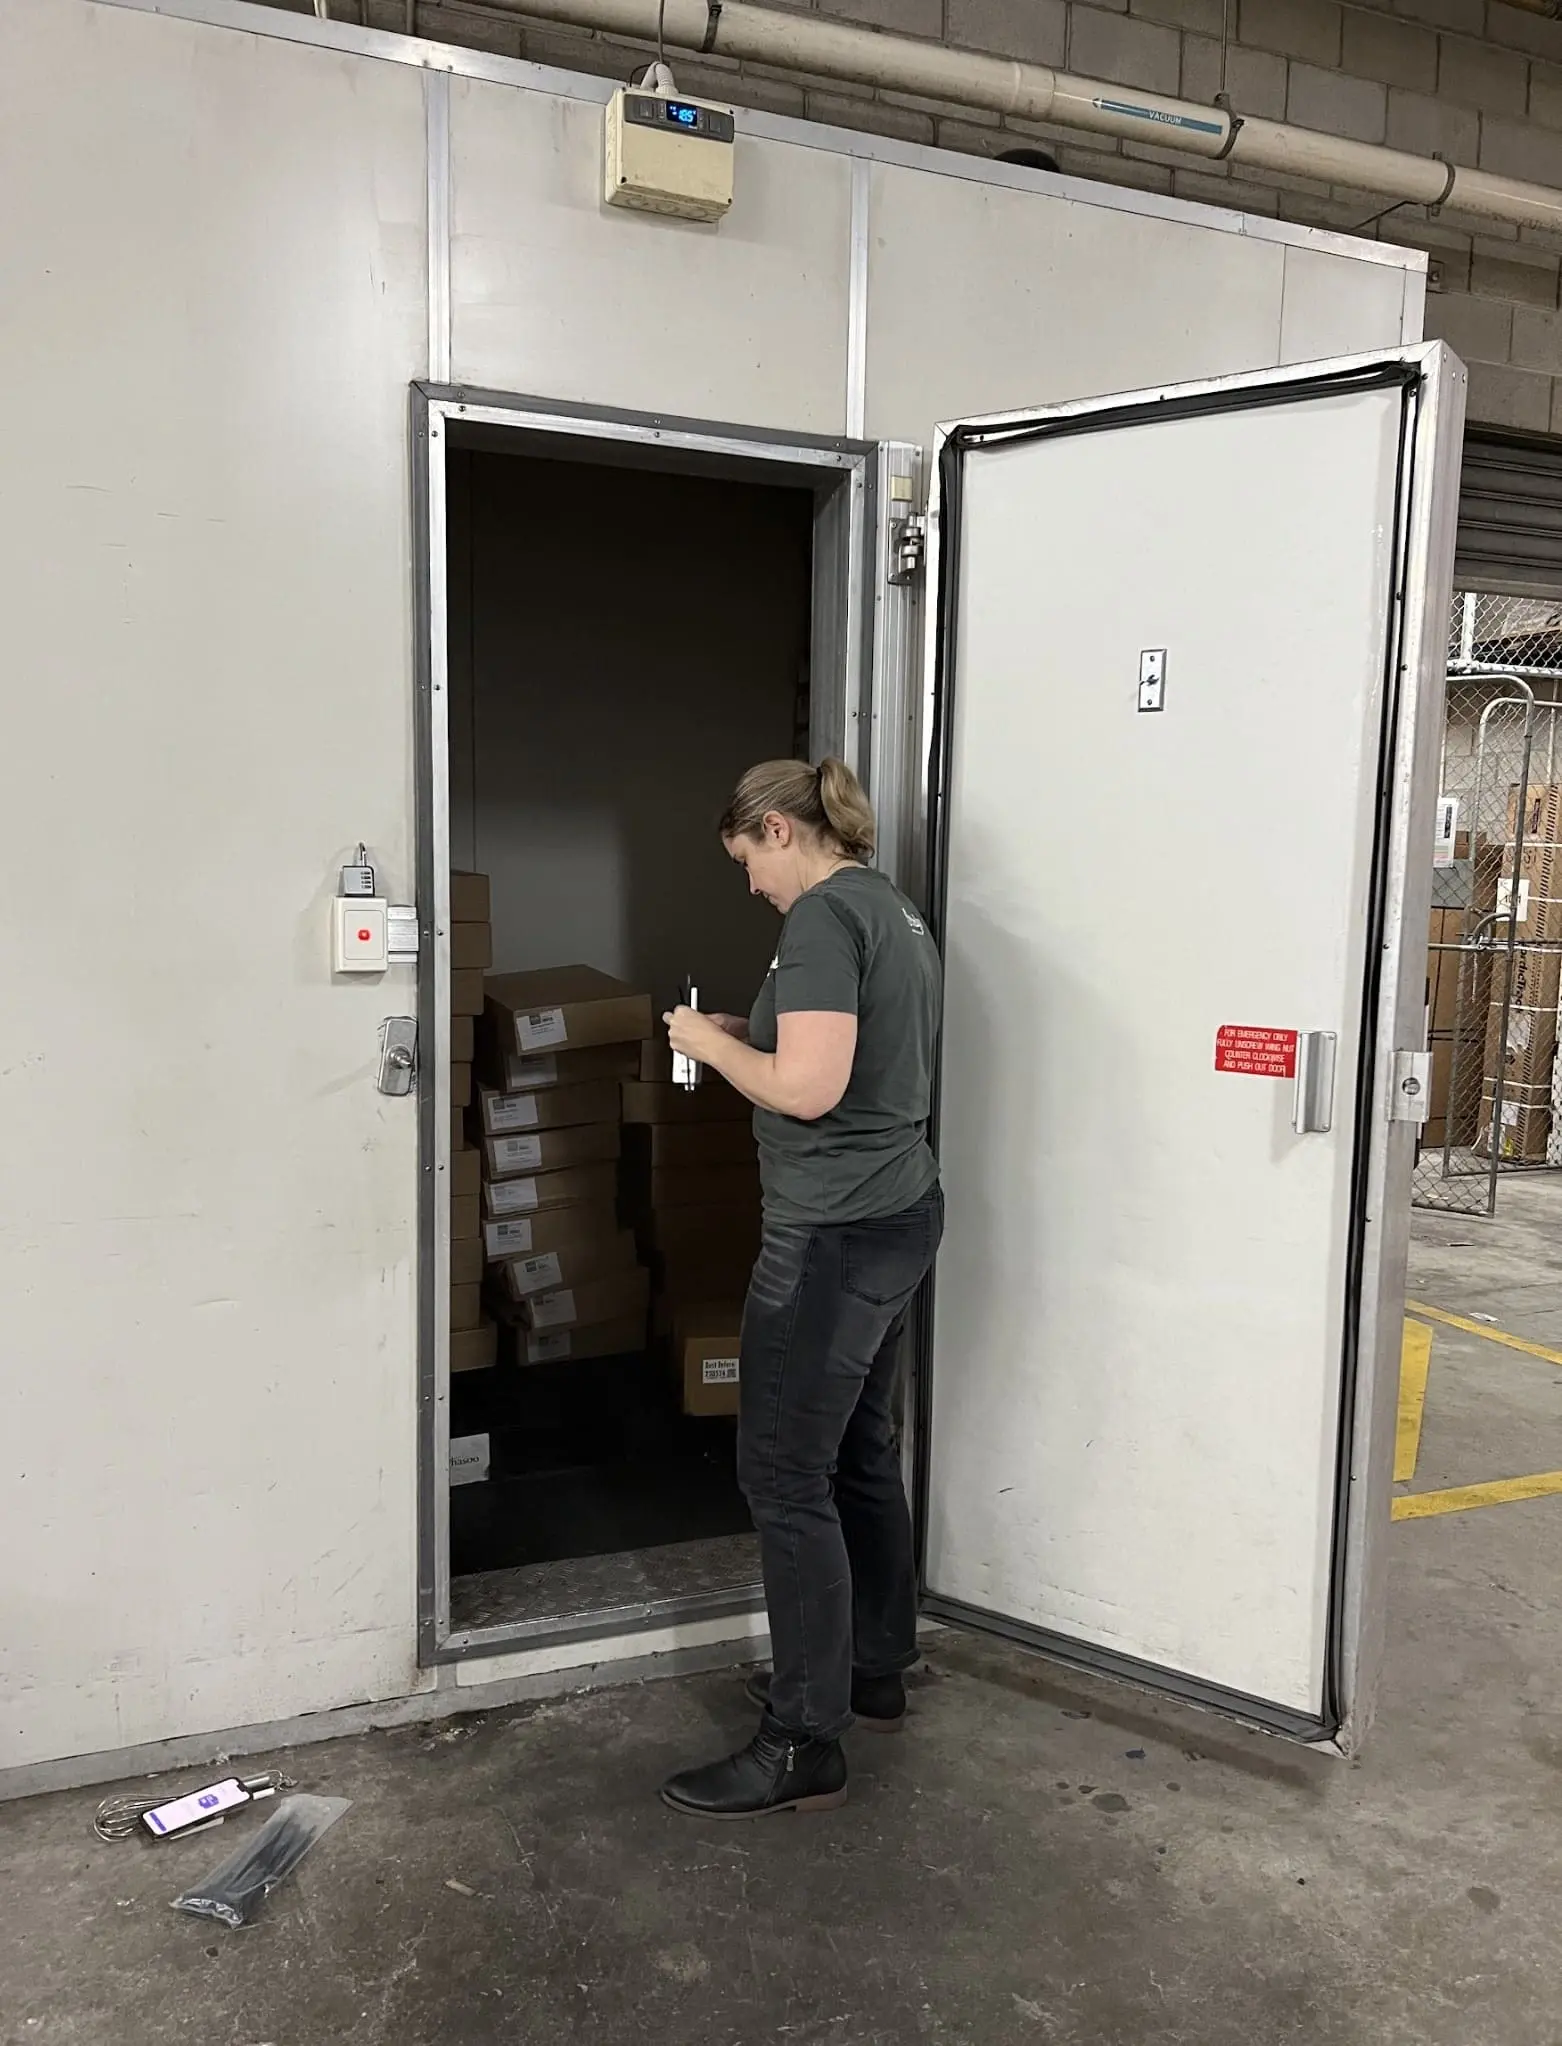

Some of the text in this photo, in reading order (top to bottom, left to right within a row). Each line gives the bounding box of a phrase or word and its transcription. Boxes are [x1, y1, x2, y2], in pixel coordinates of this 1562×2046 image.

[1149, 111, 1181, 125] VACUUM
[1516, 941, 1528, 1014] ordicTrack
[1224, 1029, 1288, 1041] FOR EMERGENCY ONLY
[1217, 1039, 1295, 1053] FULLY UNSCREW WING NUT
[1225, 1050, 1285, 1062] COUNTER CLOCKWISE
[1224, 1060, 1286, 1073] AND PUSH OUT DOOR
